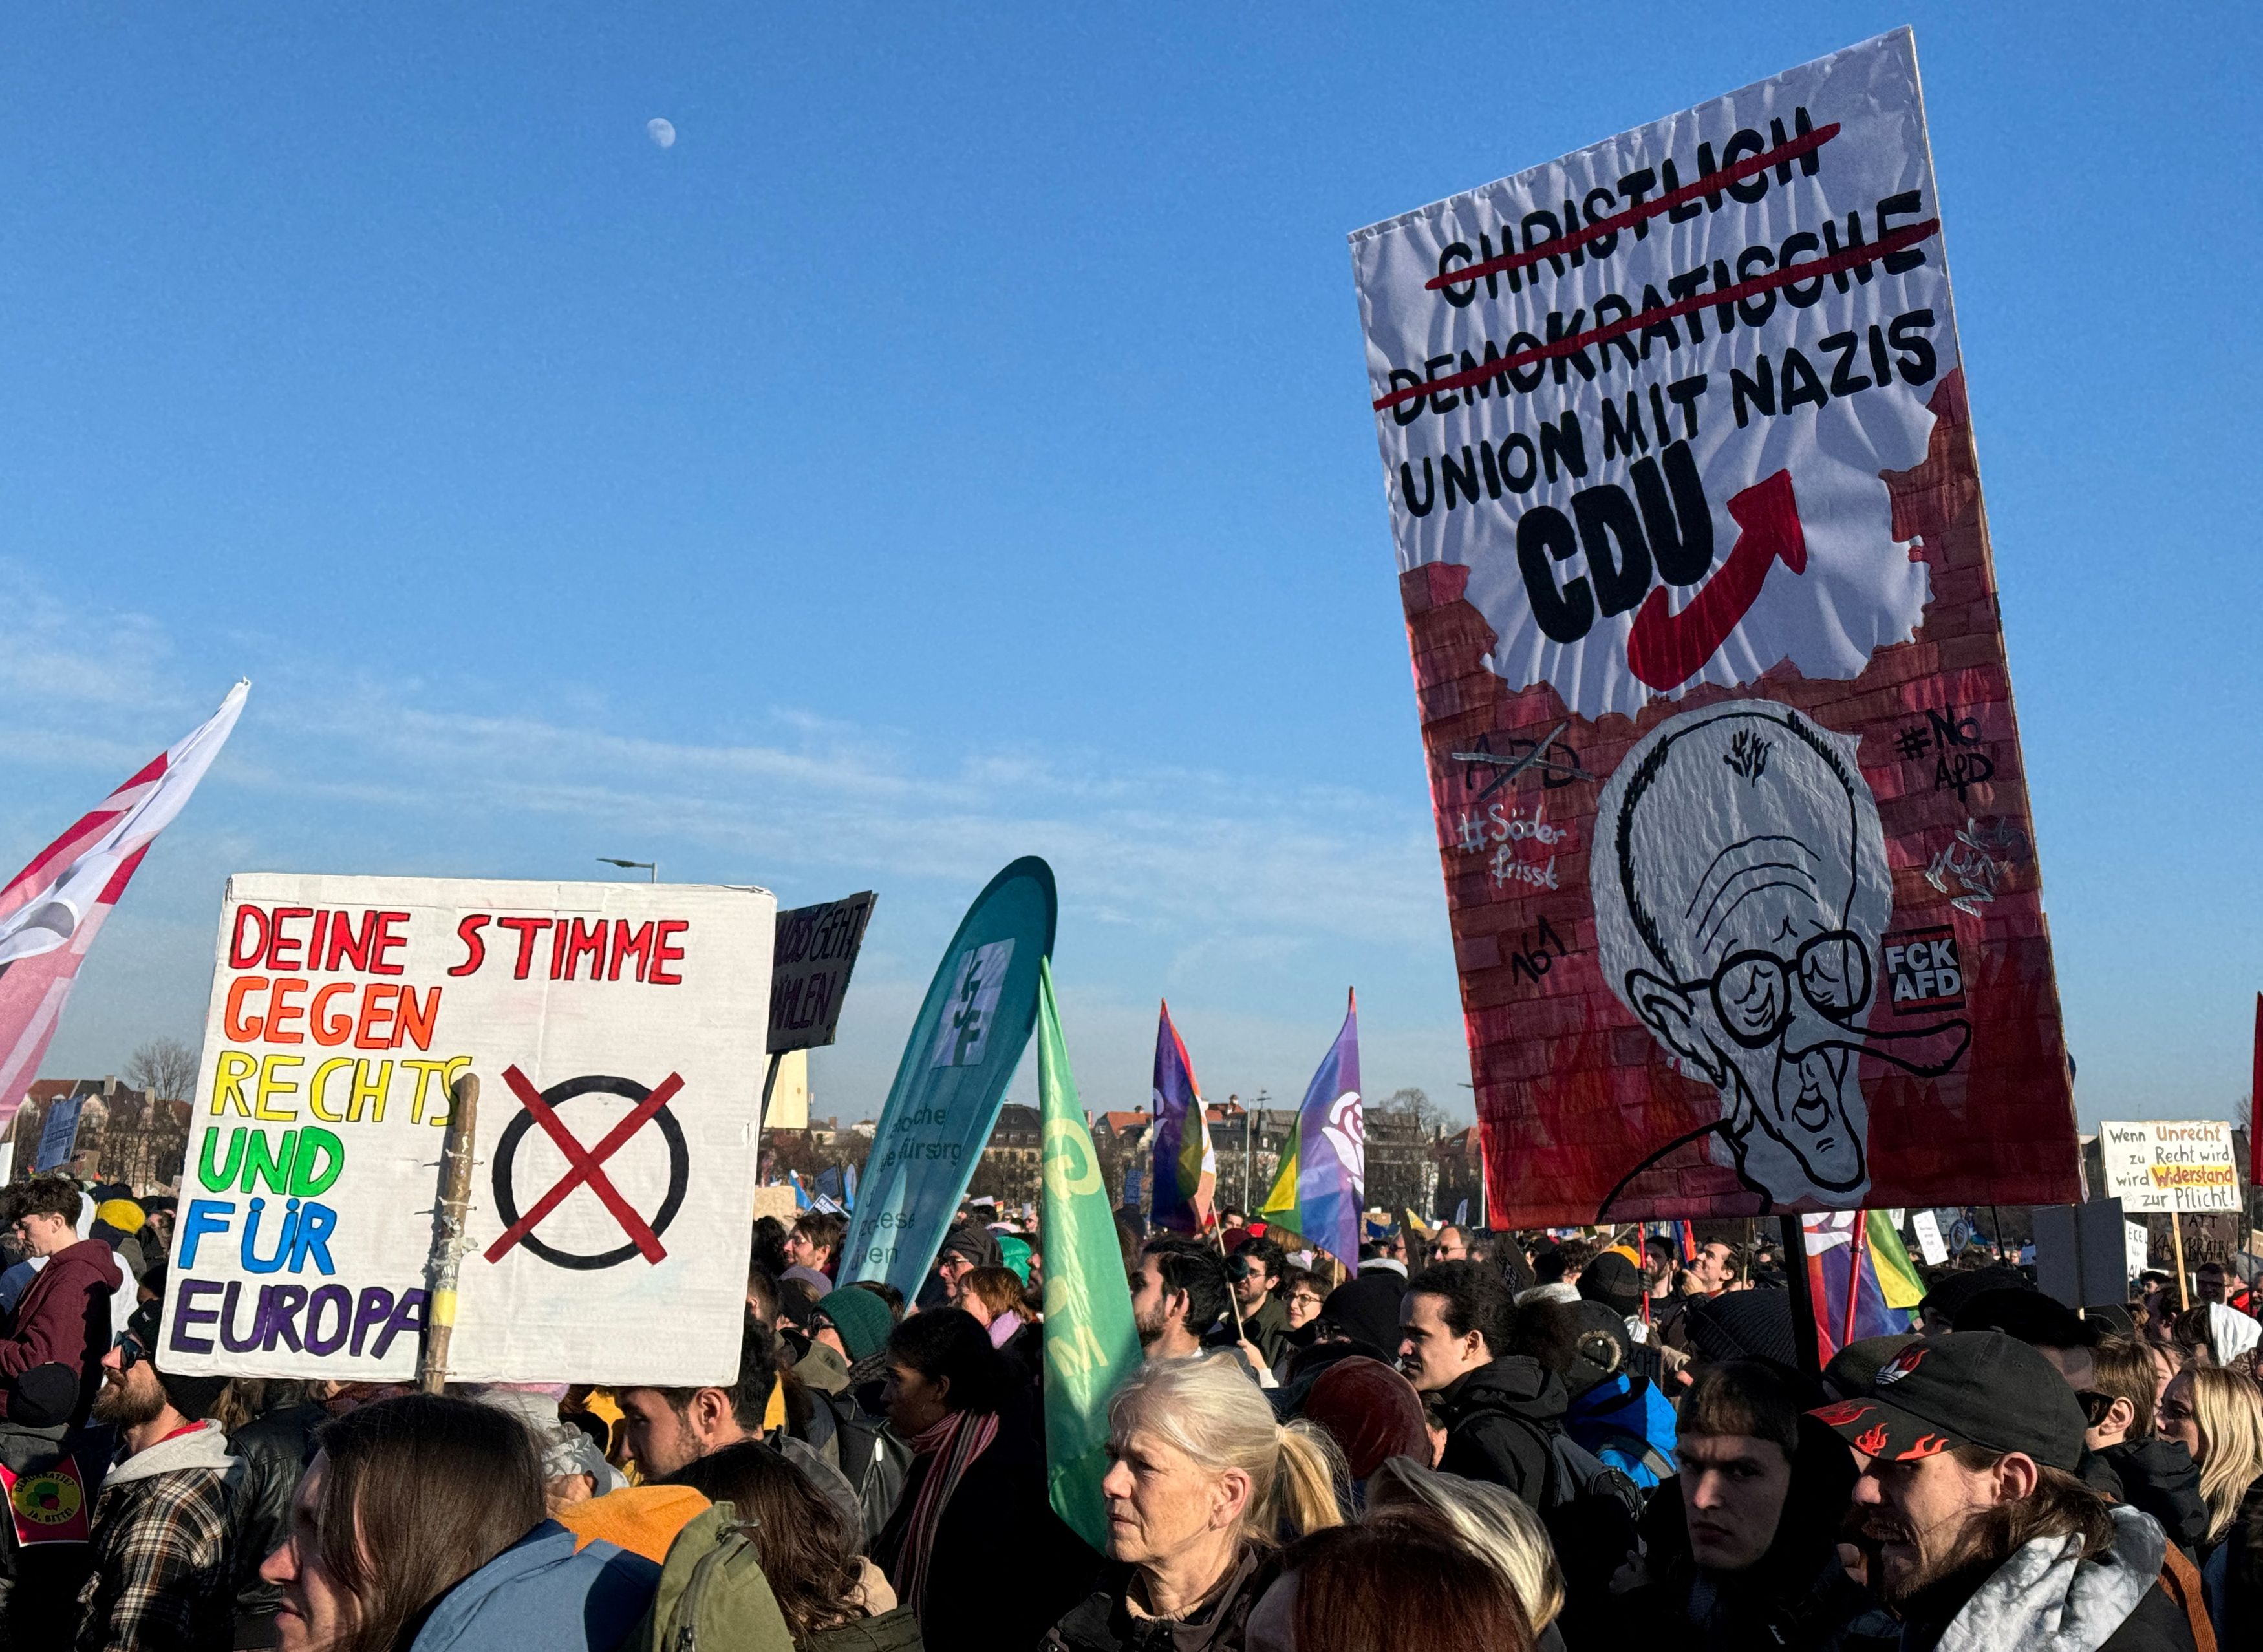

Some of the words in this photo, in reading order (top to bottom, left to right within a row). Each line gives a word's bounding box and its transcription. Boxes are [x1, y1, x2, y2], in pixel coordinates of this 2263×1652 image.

[1439, 105, 1822, 308] CHRISTLICH
[1388, 189, 1927, 427] DEMOKRATISCHE
[1400, 409, 1589, 517] UNION
[1602, 374, 1708, 462] MIT
[1730, 309, 1937, 429] NAZIS
[1516, 438, 1715, 645] CDU
[229, 904, 411, 976] DEINE
[447, 914, 690, 985] STIMME
[1885, 938, 1958, 974] FCK
[224, 976, 443, 1051] GEGEN
[1893, 967, 1962, 1002] AFD
[209, 1050, 473, 1126] RECHTS
[198, 1126, 345, 1197] UND
[2109, 1128, 2146, 1144] Wenn
[2156, 1126, 2222, 1142] Unrecht
[2129, 1155, 2145, 1164] zu
[2154, 1144, 2195, 1165] Recht
[2116, 1169, 2150, 1186] wird
[2151, 1164, 2233, 1187] Widerstand
[2141, 1194, 2169, 1207] zur
[2174, 1185, 2235, 1209] Pflicht!
[177, 1197, 338, 1276] FÜR
[169, 1279, 429, 1360] EUROPA
